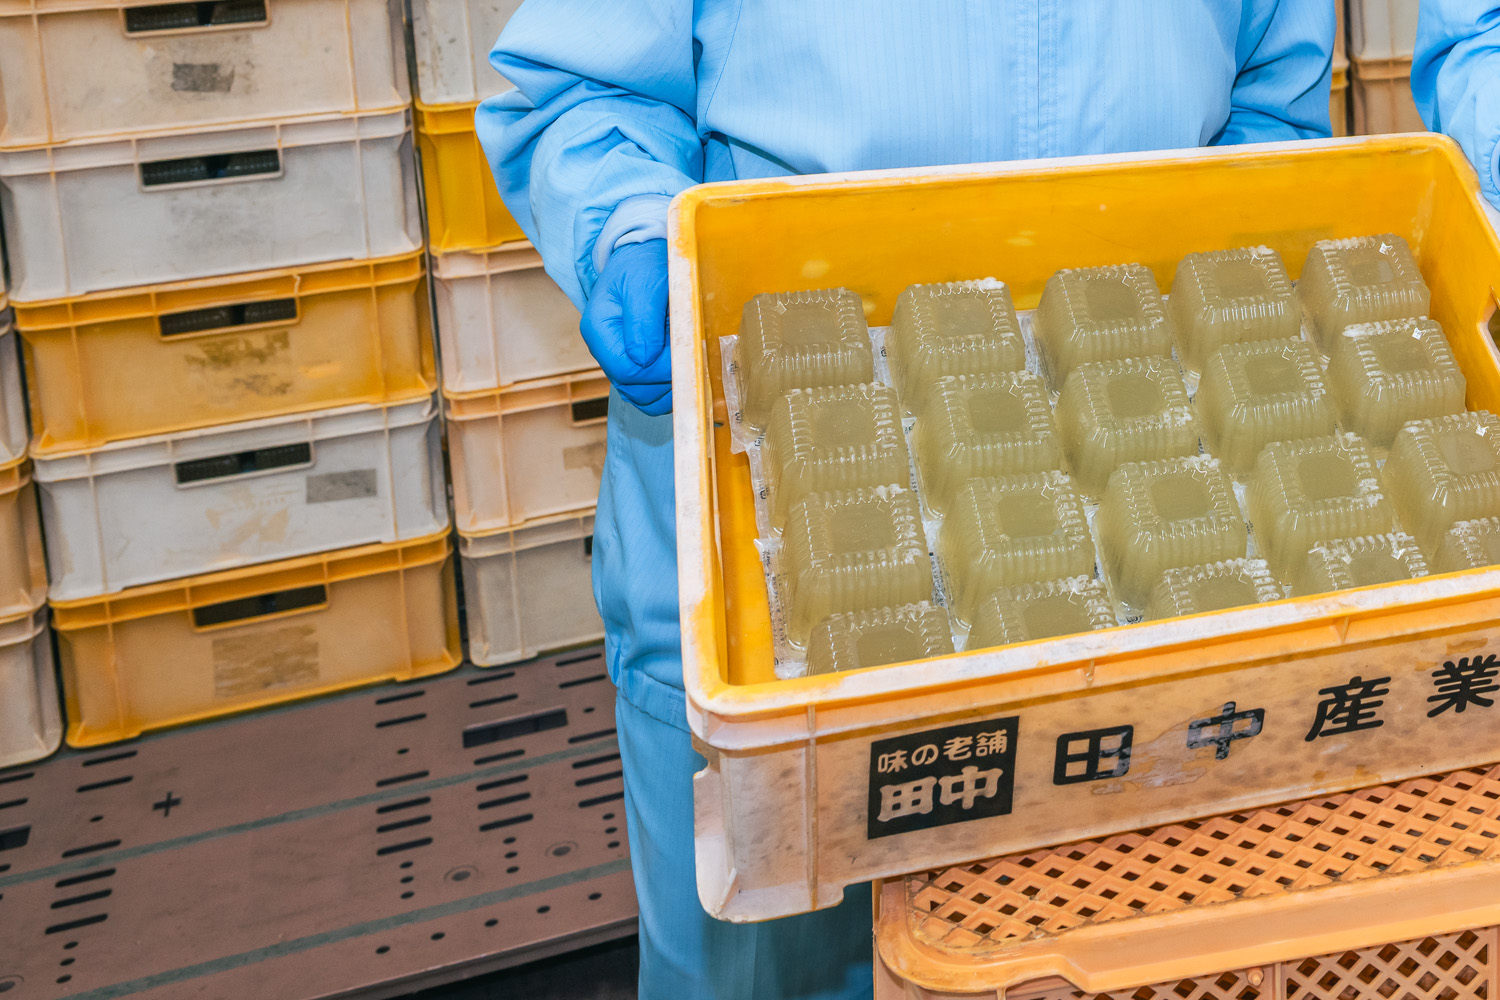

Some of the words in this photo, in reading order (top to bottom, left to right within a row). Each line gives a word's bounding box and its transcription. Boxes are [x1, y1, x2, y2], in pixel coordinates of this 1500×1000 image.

[877, 728, 1008, 774] 味の老舗
[877, 765, 1004, 822] 田中
